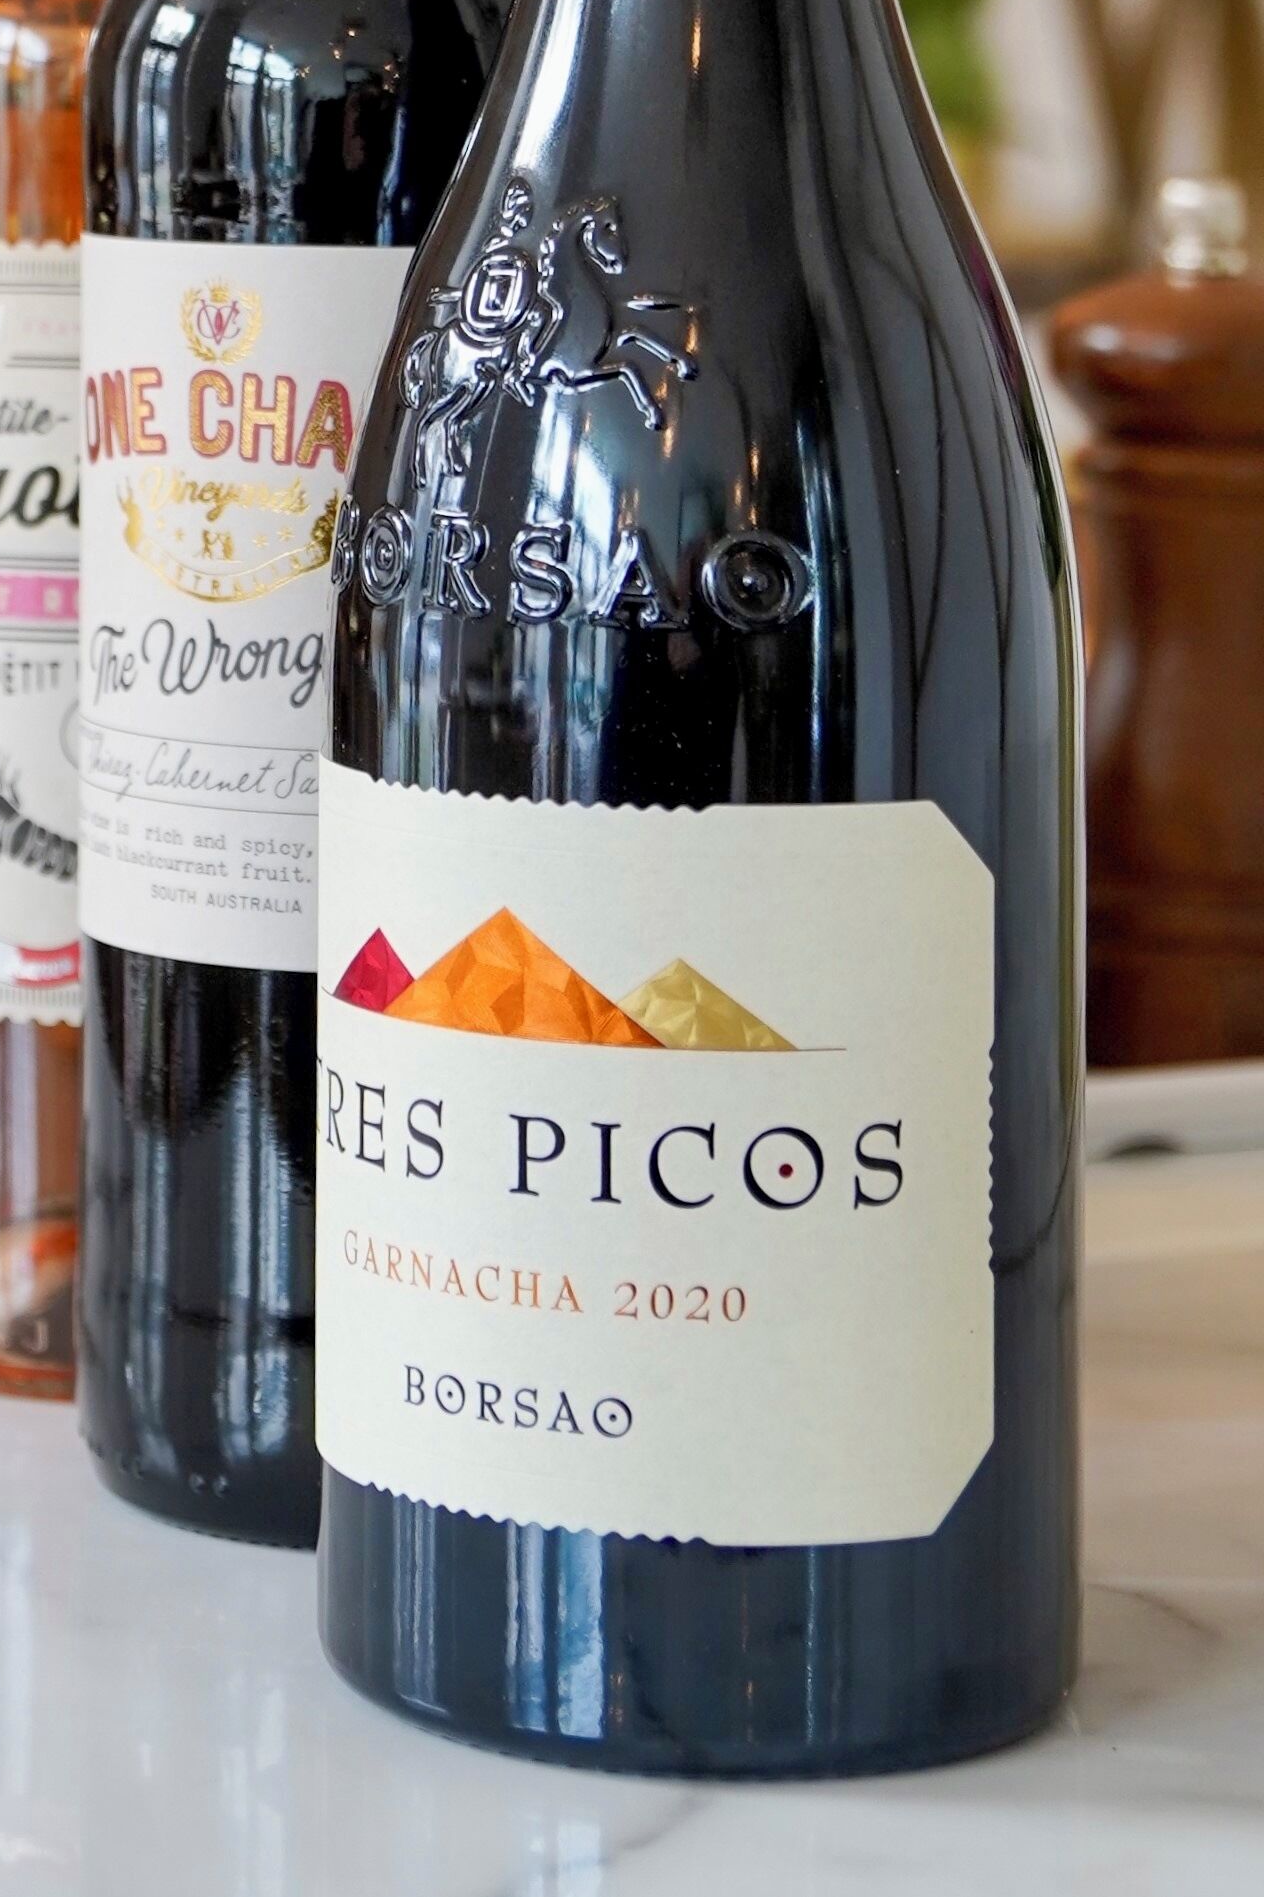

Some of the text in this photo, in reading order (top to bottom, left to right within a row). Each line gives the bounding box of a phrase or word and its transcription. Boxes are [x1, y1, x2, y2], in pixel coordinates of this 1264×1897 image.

[86, 366, 354, 473] ONE CHA
[331, 498, 810, 631] BORSAO
[90, 617, 324, 708] The Wrong
[145, 825, 183, 846] rich
[193, 834, 226, 852] and
[241, 837, 314, 859] spicy,
[241, 862, 313, 884] fruit.
[150, 883, 303, 915] SOUTH AUSTRALIA
[315, 1055, 904, 1211] RES PICOS
[343, 1229, 748, 1324] GARNACHA 2020
[402, 1364, 634, 1440] BORSAO
